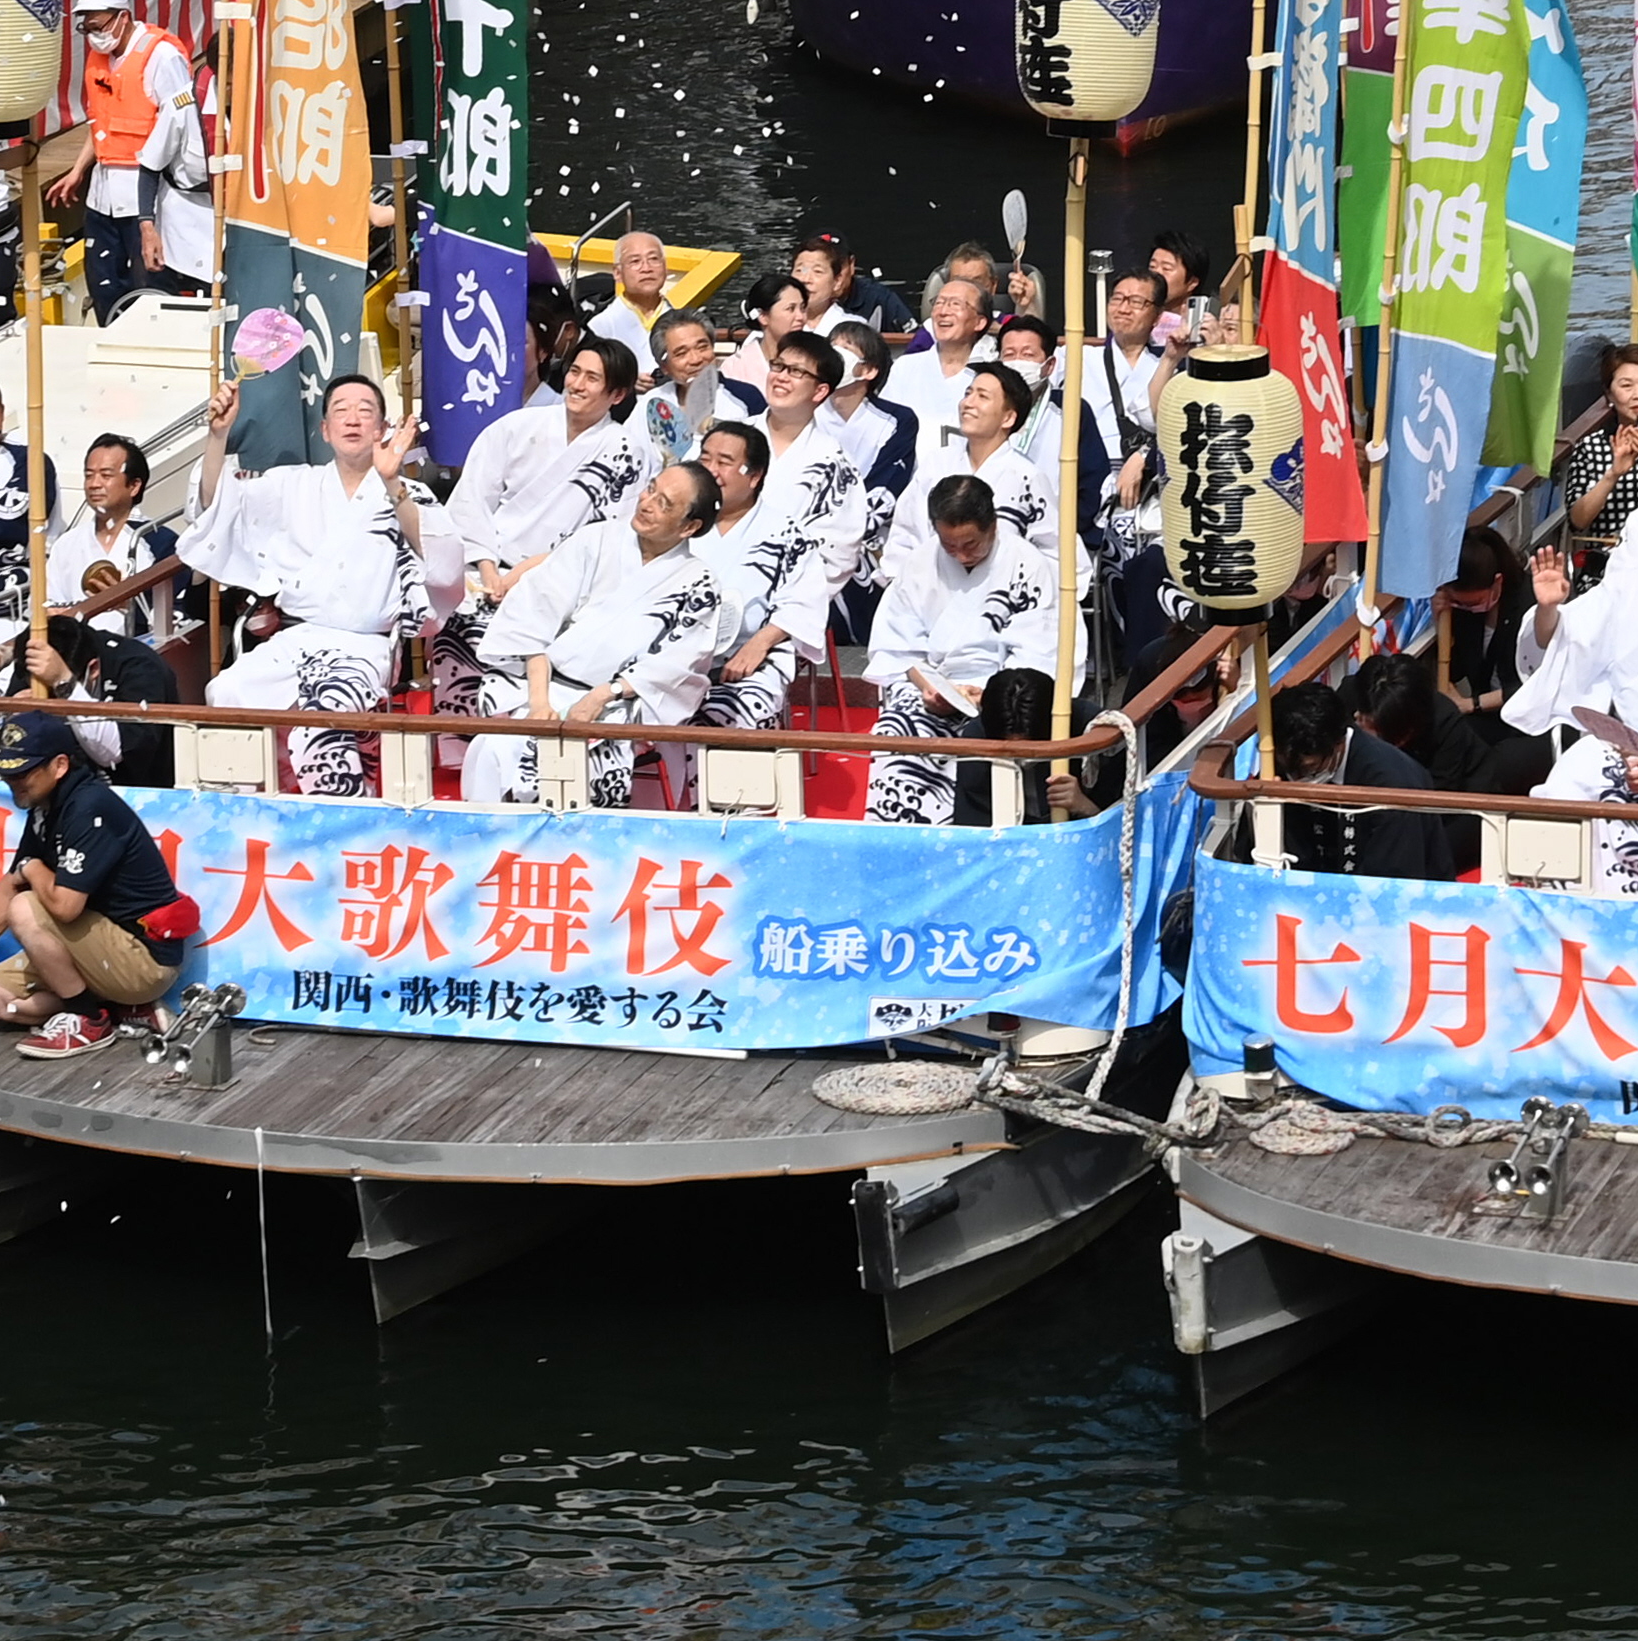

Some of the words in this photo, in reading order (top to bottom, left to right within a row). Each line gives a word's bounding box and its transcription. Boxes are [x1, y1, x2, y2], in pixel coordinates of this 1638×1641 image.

[1180, 399, 1259, 599] 松竹座
[757, 915, 1039, 980] 船乗り込み
[291, 968, 728, 1036] 関西・歌舞伎を愛する会
